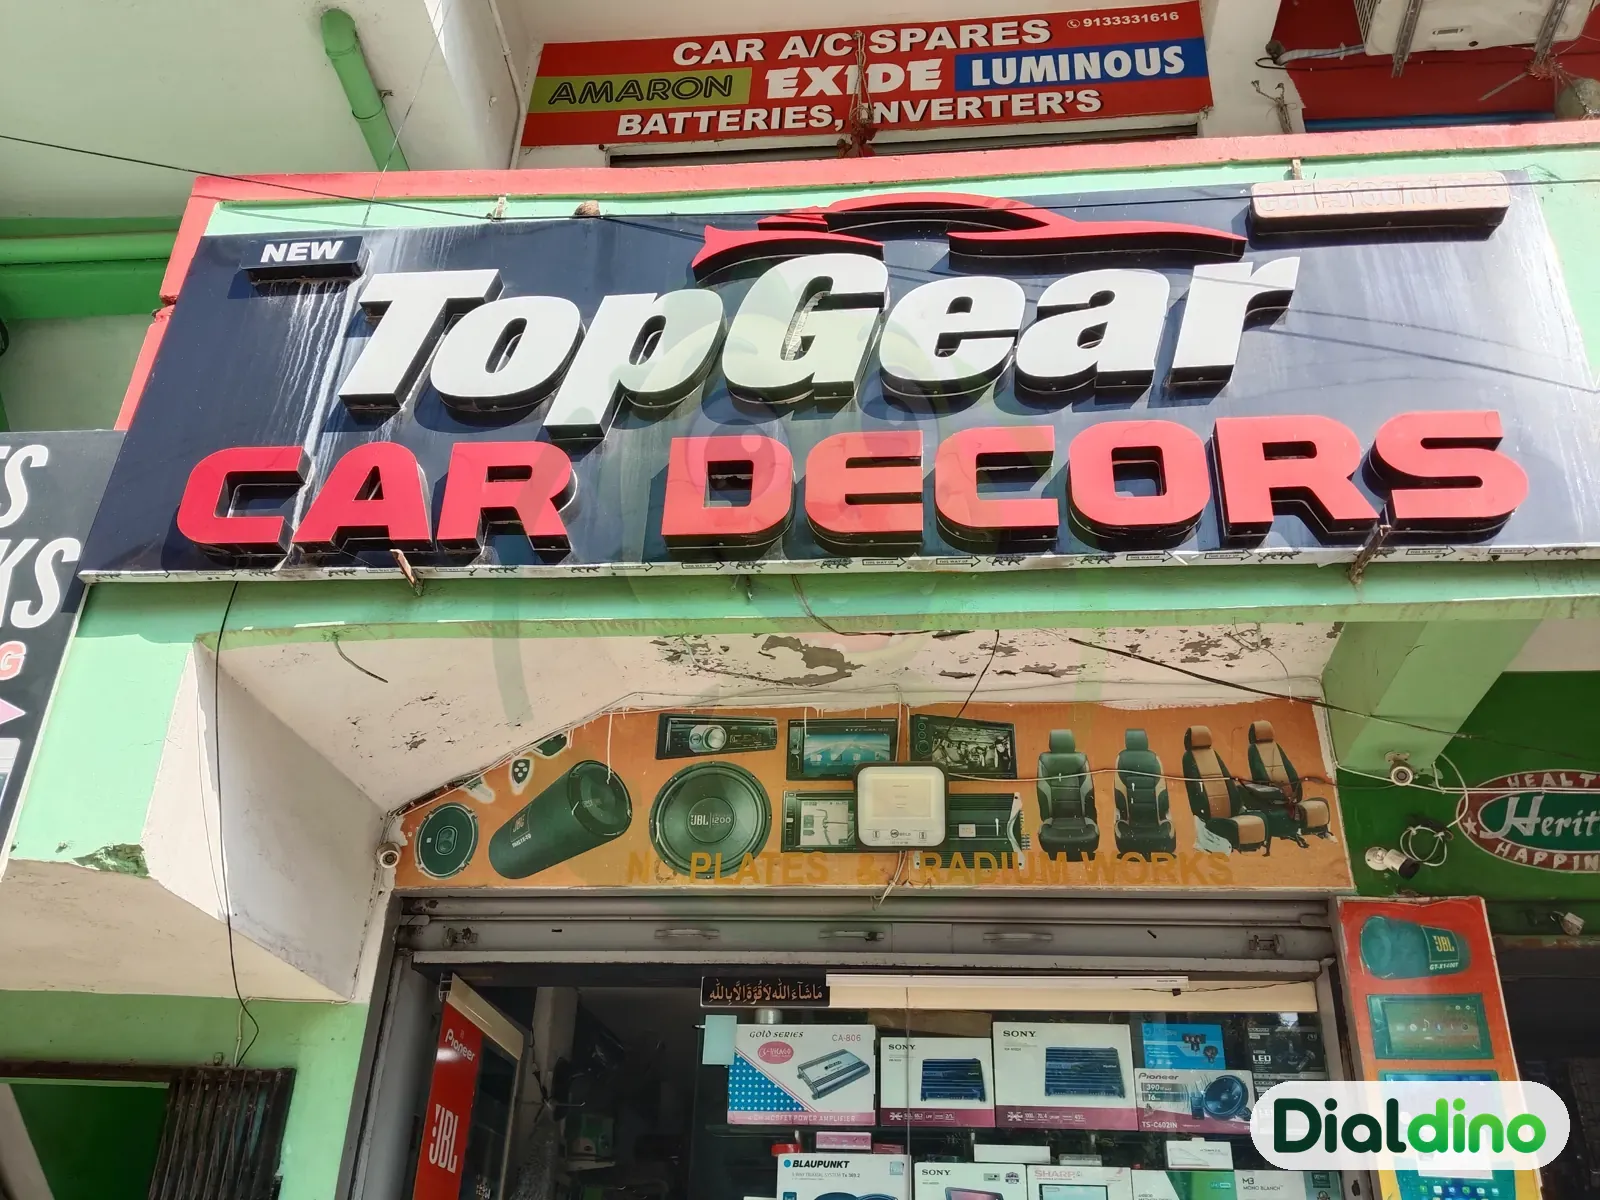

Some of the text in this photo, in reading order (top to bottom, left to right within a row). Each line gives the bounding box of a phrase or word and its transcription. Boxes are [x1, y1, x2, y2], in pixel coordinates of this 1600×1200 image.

[1082, 11, 1180, 28] 9133331616
[673, 19, 1051, 66] CAR A/C SPARES
[764, 58, 943, 99] EXIDE
[971, 46, 1185, 87] LUMINOUS
[548, 75, 733, 105] AMARON
[616, 104, 845, 136] BATTERIES,
[260, 240, 344, 263] NEW
[339, 252, 1300, 434] TopGear
[0, 444, 49, 529] S
[177, 411, 1529, 553] CAR DECORS
[1507, 772, 1600, 789] HEALT
[690, 814, 709, 826] JBL
[1480, 795, 1600, 839] Herit
[690, 852, 829, 884] PLATES
[919, 851, 1069, 885] RADIUM
[1081, 851, 1235, 885] WORKS
[1432, 935, 1455, 952] JBL
[444, 1028, 476, 1062] Pioneer
[773, 1030, 804, 1038] SERIES
[831, 1034, 862, 1042] CA-806
[1003, 1030, 1037, 1038] SONY
[1252, 1054, 1272, 1062] LED
[1138, 1072, 1179, 1080] Pioneer
[429, 1103, 459, 1174] JBL
[792, 1159, 850, 1169] BLAUPUNKT
